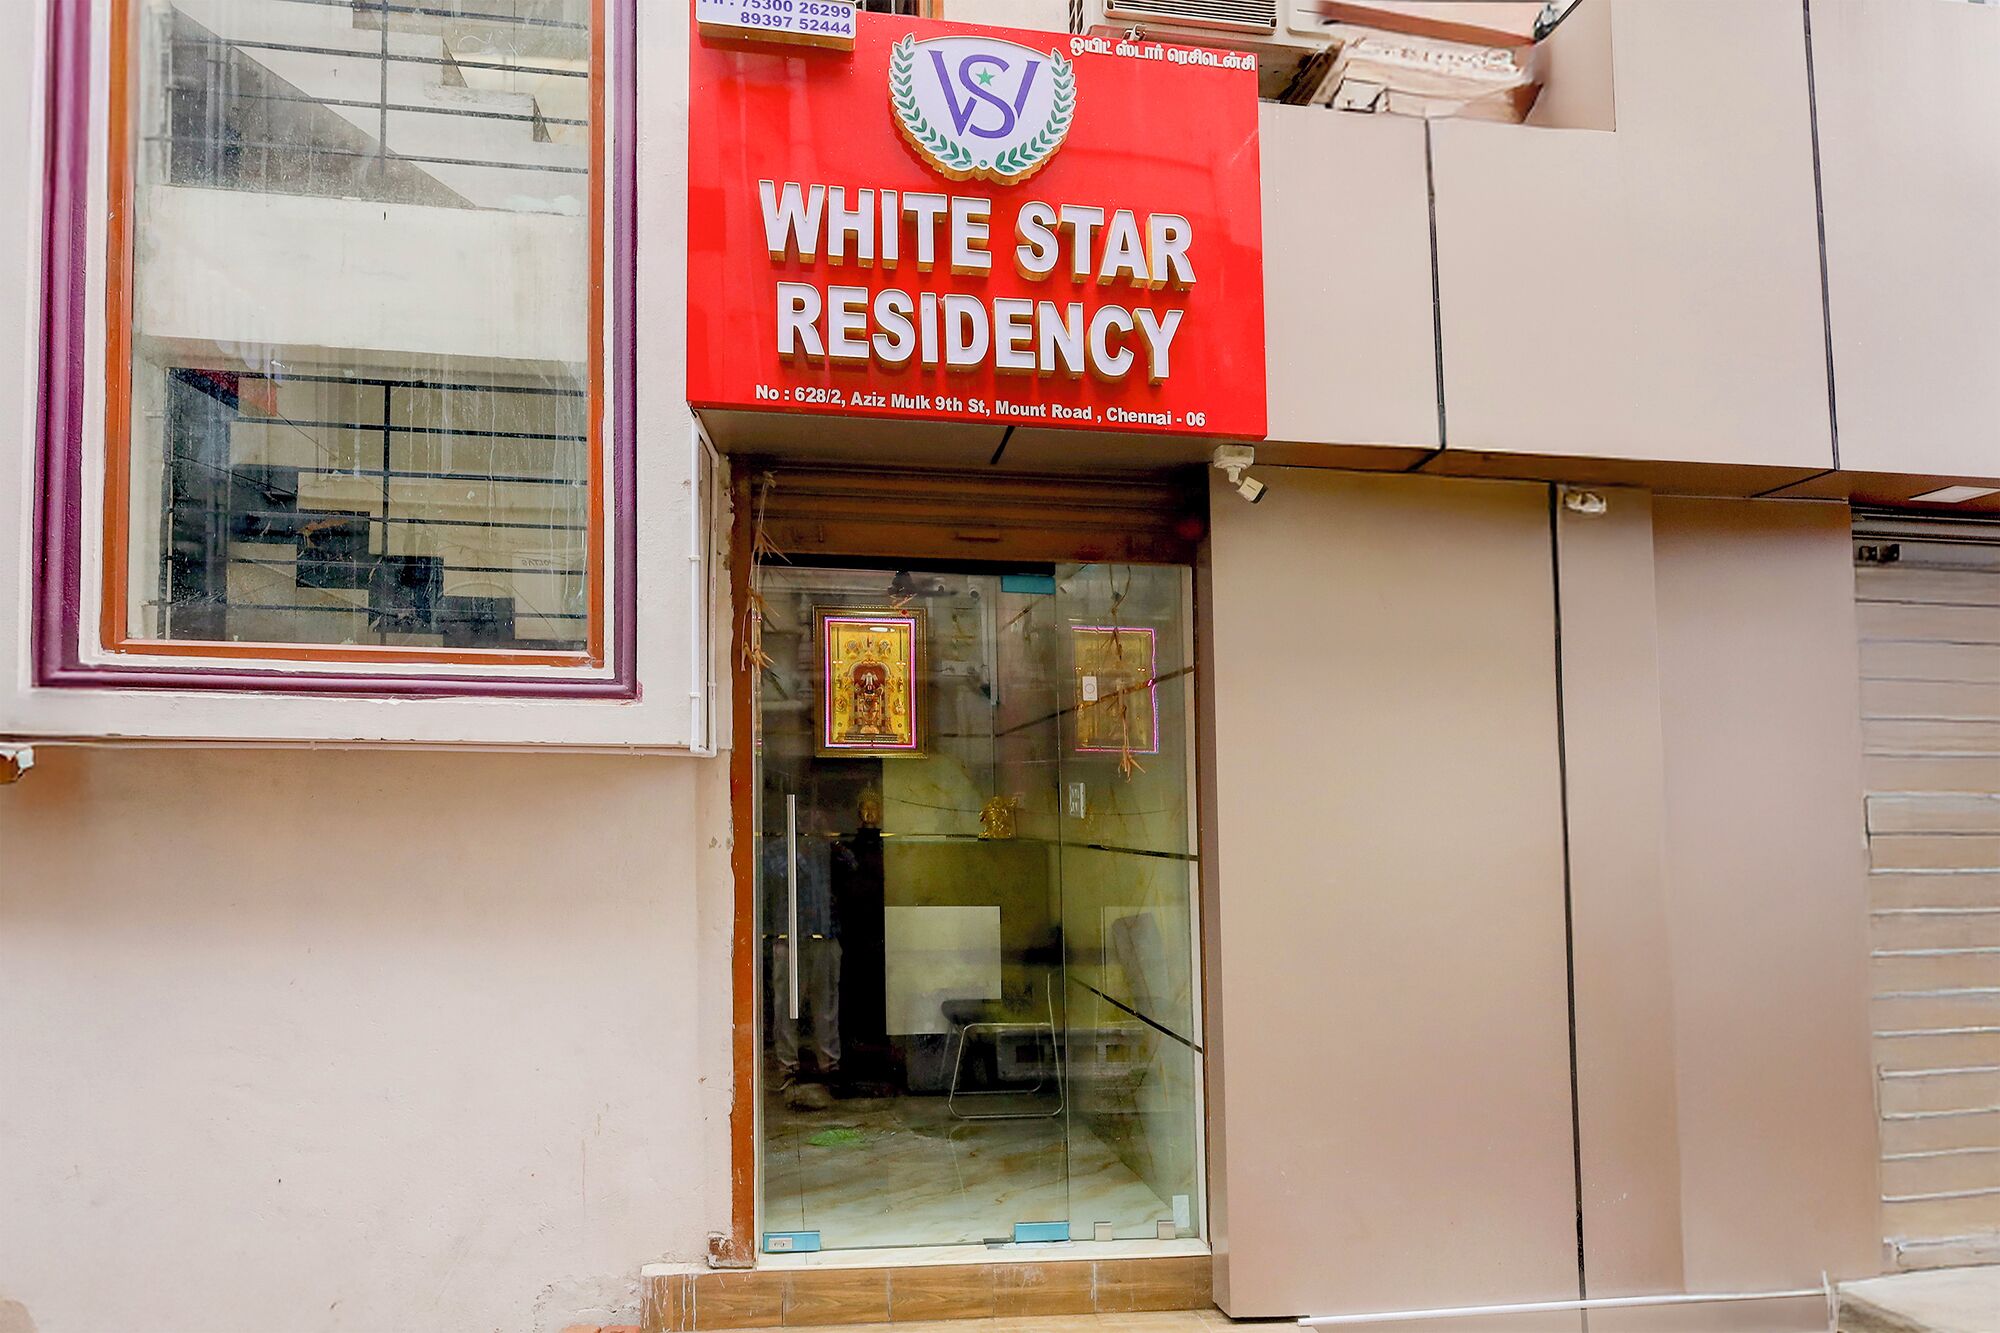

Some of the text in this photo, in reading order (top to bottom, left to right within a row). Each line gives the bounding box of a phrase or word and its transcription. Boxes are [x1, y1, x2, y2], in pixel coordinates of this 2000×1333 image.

[741, 12, 851, 35] 89397 52444
[799, 2, 850, 18] 26299
[758, 180, 1197, 284] WHITE STAR
[776, 281, 1184, 379] RESIDENCY
[755, 385, 780, 400] No
[794, 387, 846, 408] 628/2,
[850, 391, 886, 408] Aziz
[891, 394, 931, 410] Mulk
[935, 396, 963, 411] 9th
[967, 399, 990, 416] St,
[995, 400, 1047, 417] Mount
[1051, 404, 1092, 420] Road
[1106, 407, 1172, 425] Chennai
[1185, 412, 1206, 427] 06
